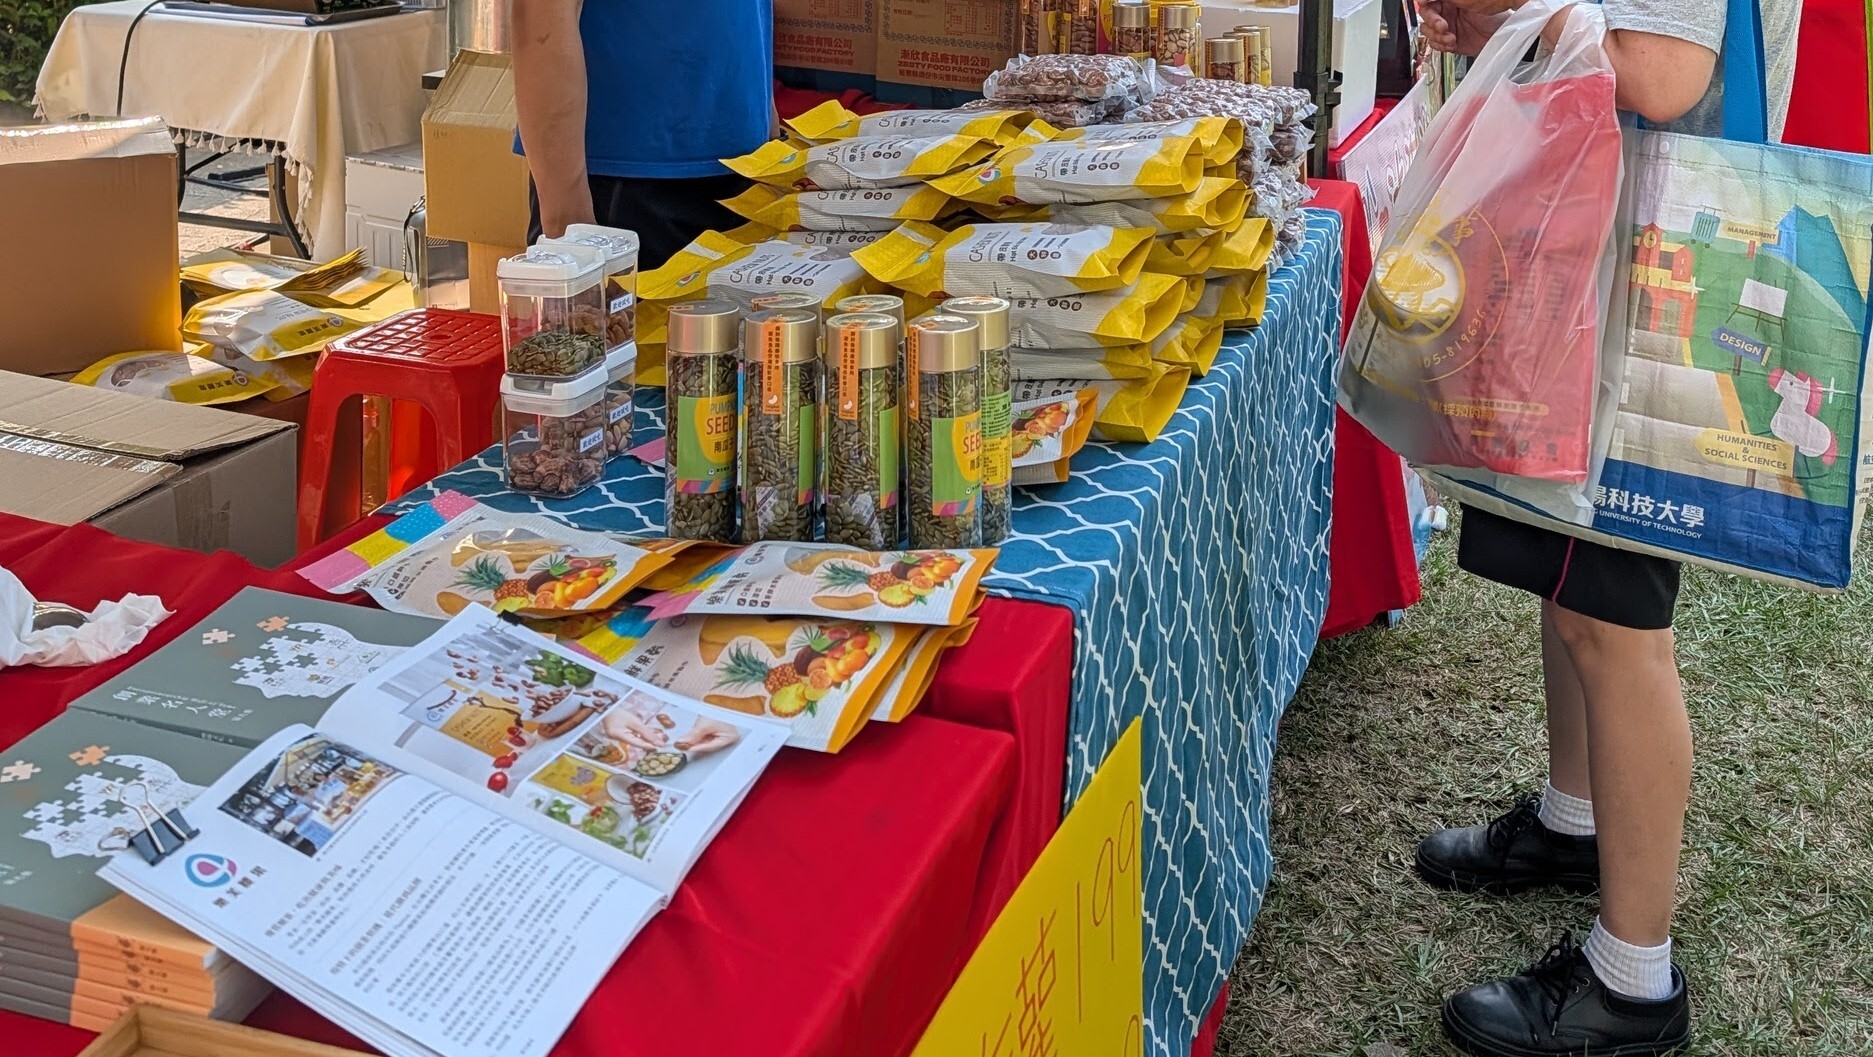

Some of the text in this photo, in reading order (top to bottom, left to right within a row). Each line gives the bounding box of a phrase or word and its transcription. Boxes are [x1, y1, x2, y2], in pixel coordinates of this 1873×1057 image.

[897, 60, 926, 69] ZESTY
[927, 63, 951, 72] FOOD
[1727, 226, 1777, 241] MANAGEMENT
[1719, 332, 1762, 355] DESIGN
[706, 415, 737, 435] SEED
[714, 438, 735, 453] 南瓜子
[1717, 433, 1778, 451] HUMANITIES
[1704, 448, 1787, 470] SOCIAL SCIENCES
[1599, 509, 1641, 525] UNIVERSITY
[1653, 522, 1703, 539] TECHNOLOGY
[1075, 799, 1137, 1024] 199
